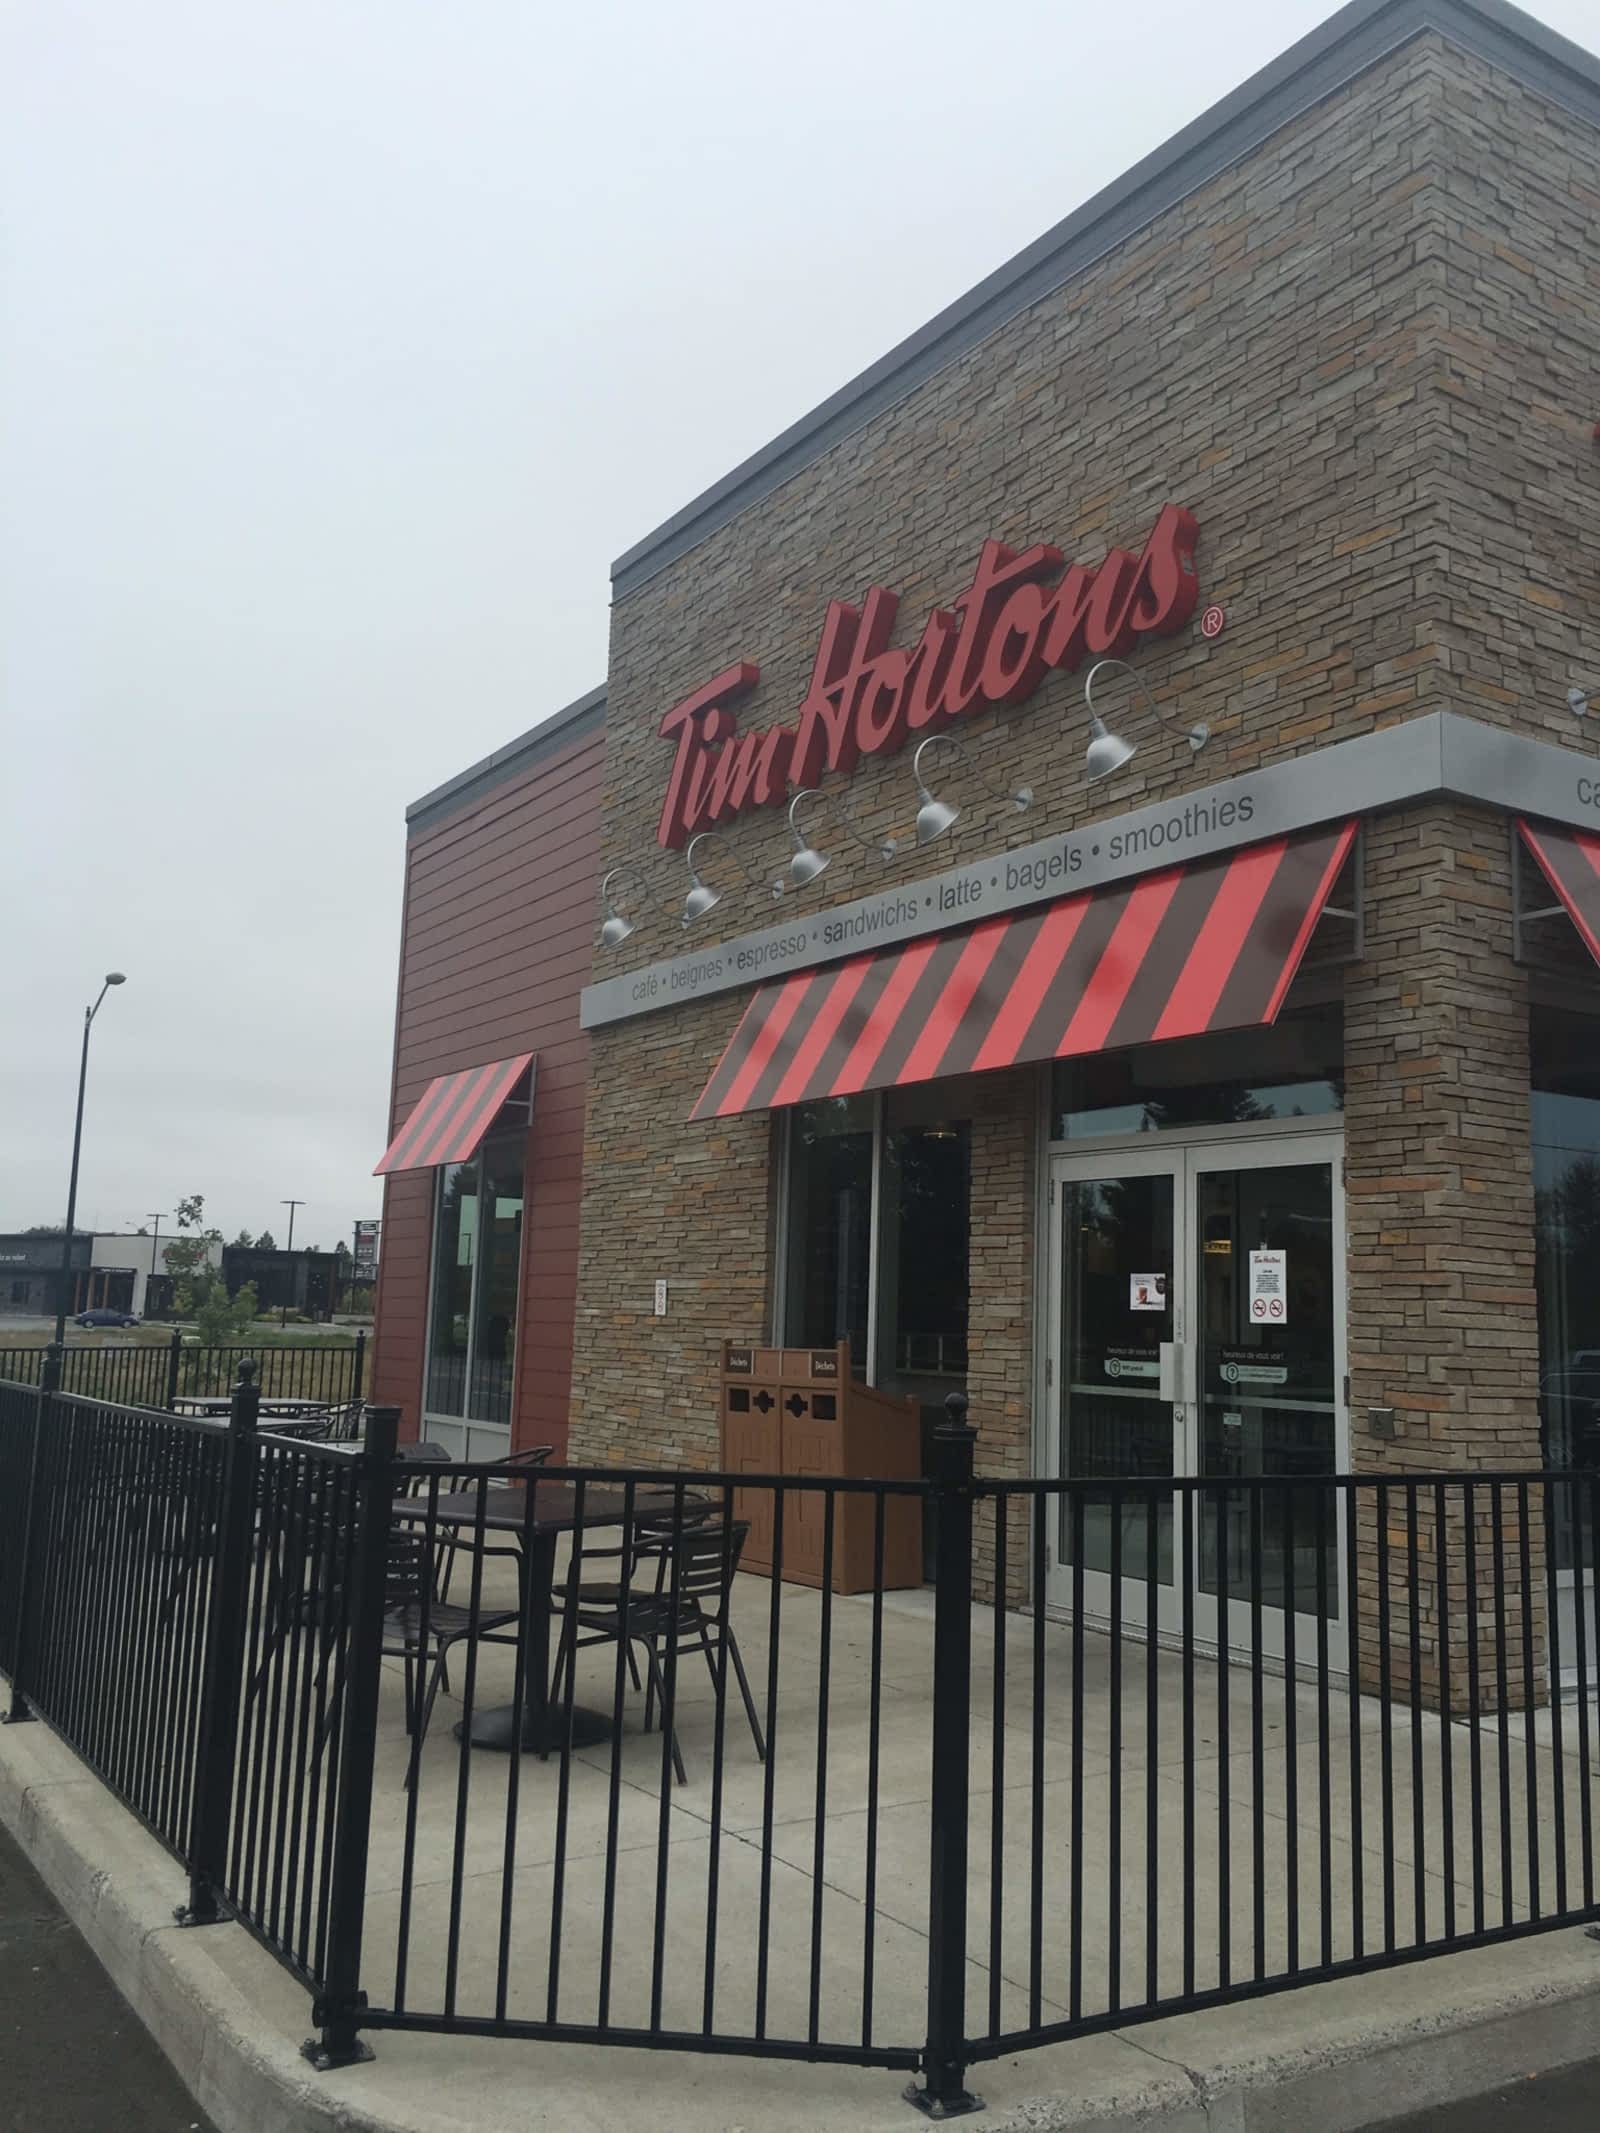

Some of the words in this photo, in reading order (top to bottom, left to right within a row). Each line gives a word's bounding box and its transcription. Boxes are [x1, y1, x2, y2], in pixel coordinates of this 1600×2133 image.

[657, 661, 790, 850] Tim
[788, 502, 1200, 787] Hortons
[631, 973, 659, 1001] café
[670, 958, 724, 990] beignes
[736, 932, 807, 971] espresso
[823, 898, 918, 945] sandwichs
[938, 875, 983, 912] latte
[1005, 845, 1083, 891] bagels
[1108, 795, 1255, 860] smoothies
